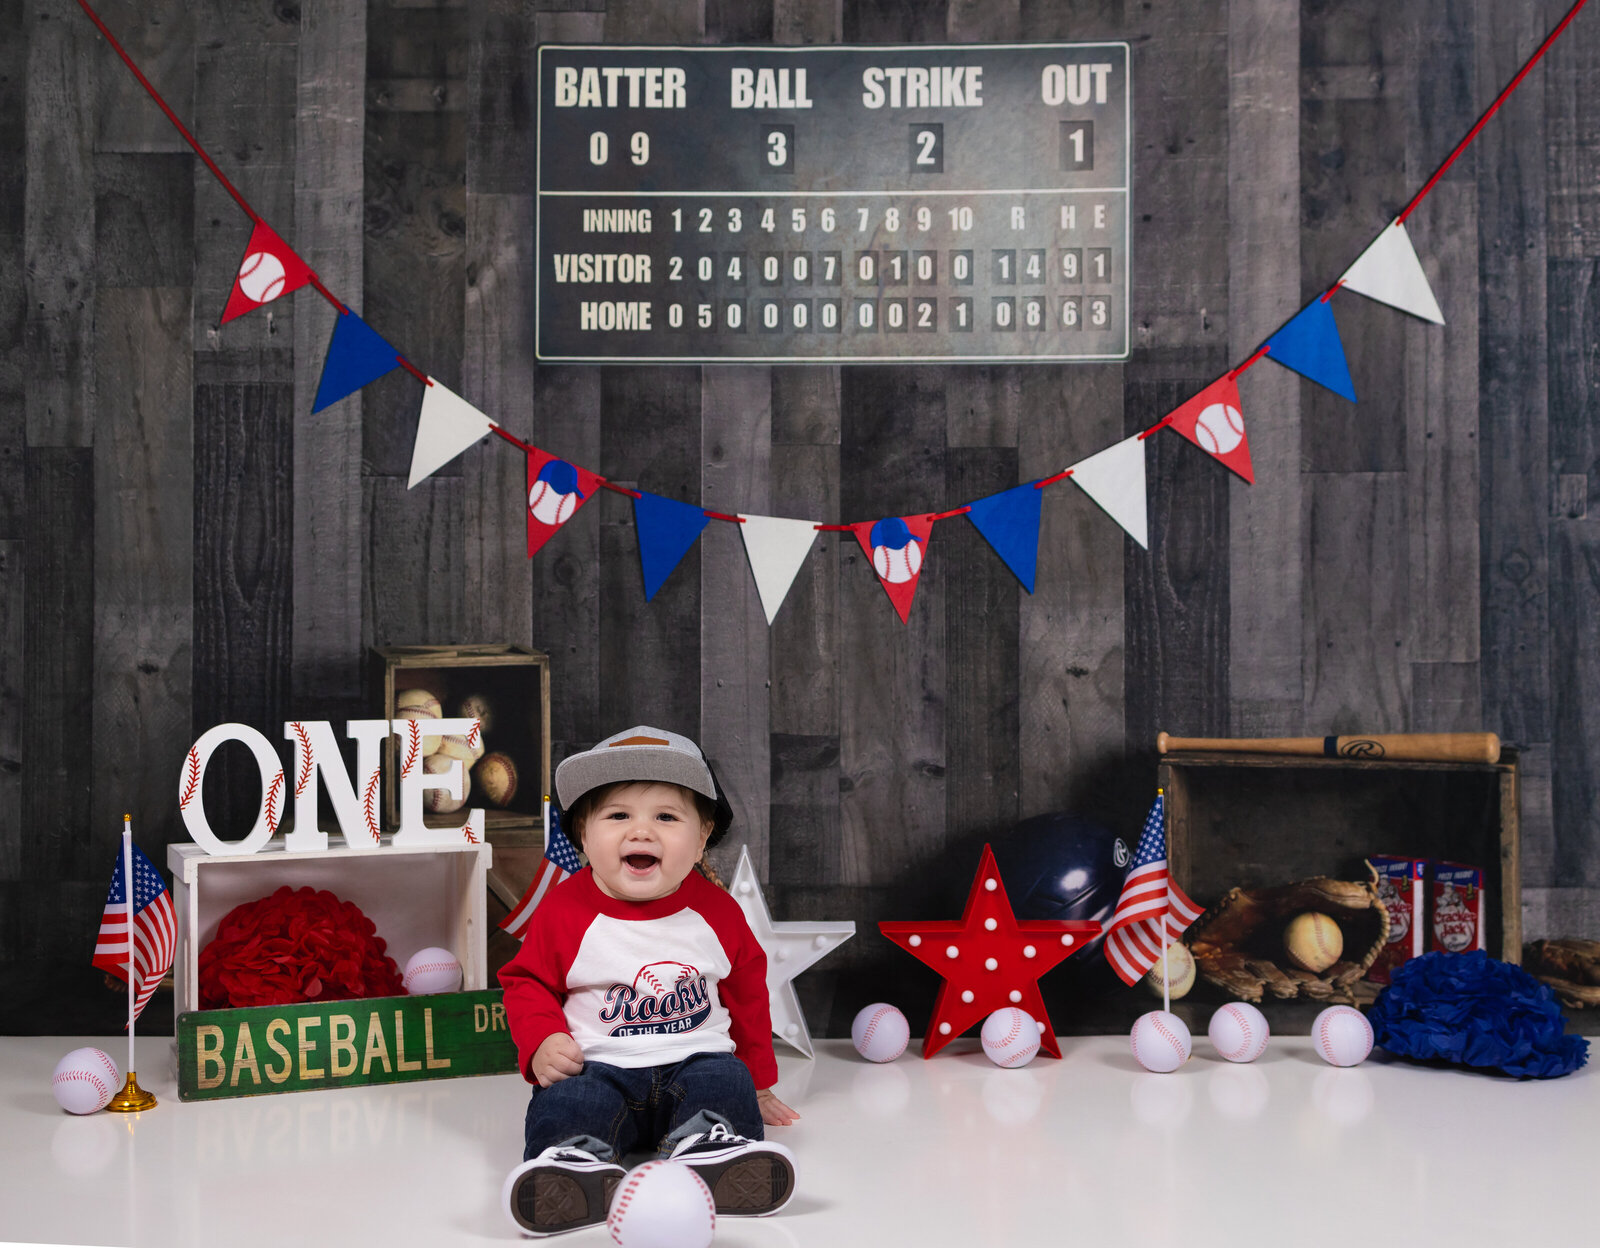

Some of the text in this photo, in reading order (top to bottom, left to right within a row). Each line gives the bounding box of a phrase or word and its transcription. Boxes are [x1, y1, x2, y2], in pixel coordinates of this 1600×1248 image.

[554, 63, 1113, 109] BATTER BALL STRIKE OUT
[589, 129, 1084, 167] 0 9 3 2 1
[582, 205, 1105, 234] INNING 1 2 3 4 5 6 7 8 9 10 R H E
[553, 253, 1105, 284] VISITOR 2 0 4 0 0 7 0 1 0 0 1 4 9 1
[580, 301, 1106, 331] HOME 0 5 0 0 0 0 0 0 2 1 0 8 6 3
[179, 717, 485, 856] ONE
[1434, 912, 1477, 925] Cracker
[1441, 923, 1466, 937] Jack
[599, 976, 709, 1023] Rookie
[618, 1017, 693, 1037] OF THE YEAR
[196, 1007, 451, 1090] BASEBALL
